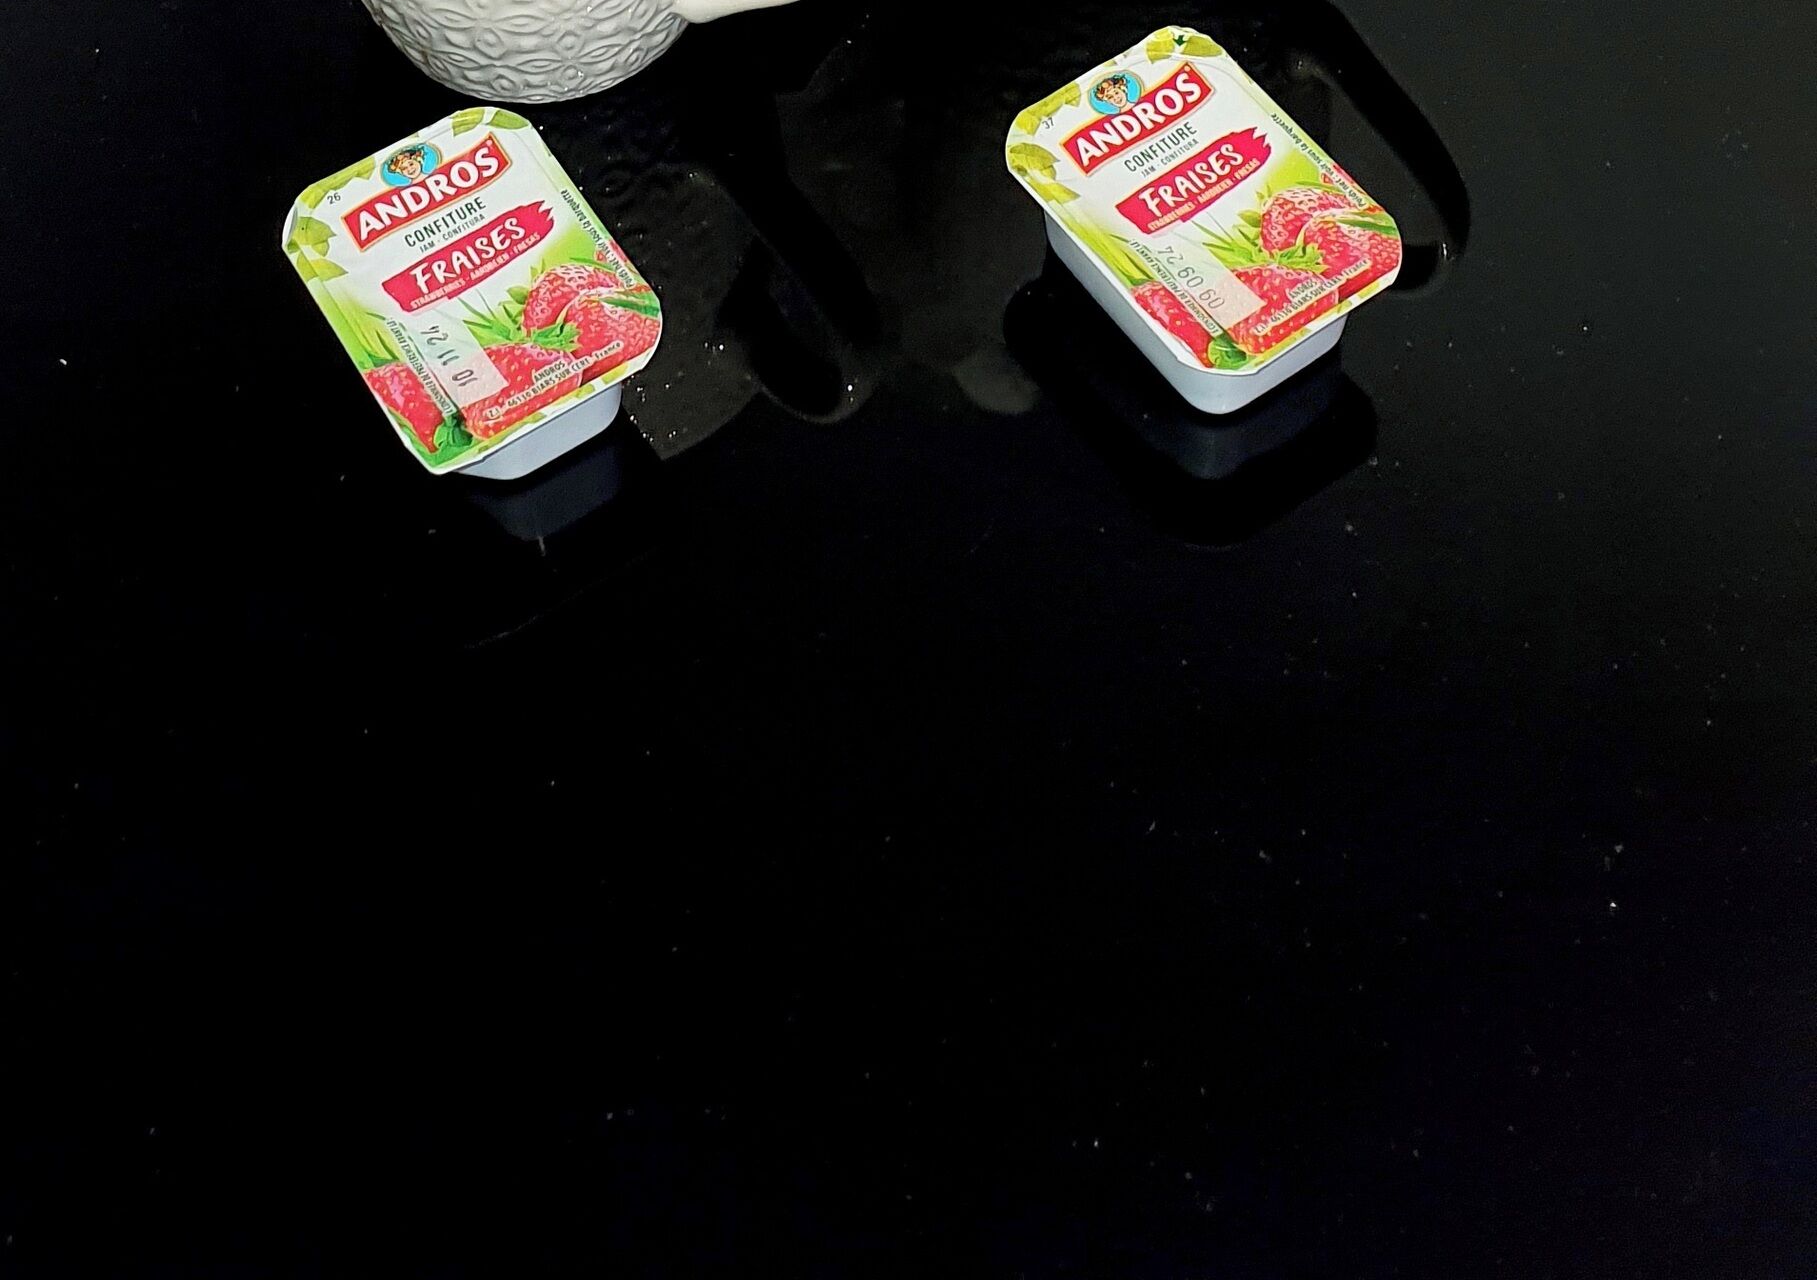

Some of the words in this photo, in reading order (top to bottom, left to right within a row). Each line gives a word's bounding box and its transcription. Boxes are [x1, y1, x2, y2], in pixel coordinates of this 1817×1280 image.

[1041, 115, 1054, 130] 37
[1075, 71, 1198, 167] ANDROS
[1269, 112, 1302, 145] barquette
[1123, 120, 1198, 173] CONFITURE
[1140, 164, 1156, 178] JAM
[1160, 137, 1200, 166] CONFITURA
[1298, 142, 1309, 152] la
[1305, 148, 1322, 165] sous
[1137, 141, 1245, 218] FRAISES
[325, 191, 342, 205] 26
[361, 145, 499, 241] ANDROS
[1346, 188, 1366, 209] Poids
[403, 195, 487, 248] CONFITURE
[418, 239, 436, 253] JAM
[441, 212, 486, 241] CONFITURA
[586, 226, 602, 244] sous
[408, 215, 527, 295] FRAISES
[1156, 244, 1184, 268] 24
[1175, 264, 1205, 291] 09
[1197, 286, 1225, 312] 09
[436, 346, 460, 367] 11
[450, 365, 478, 390] 10
[532, 359, 566, 383] ANDROS
